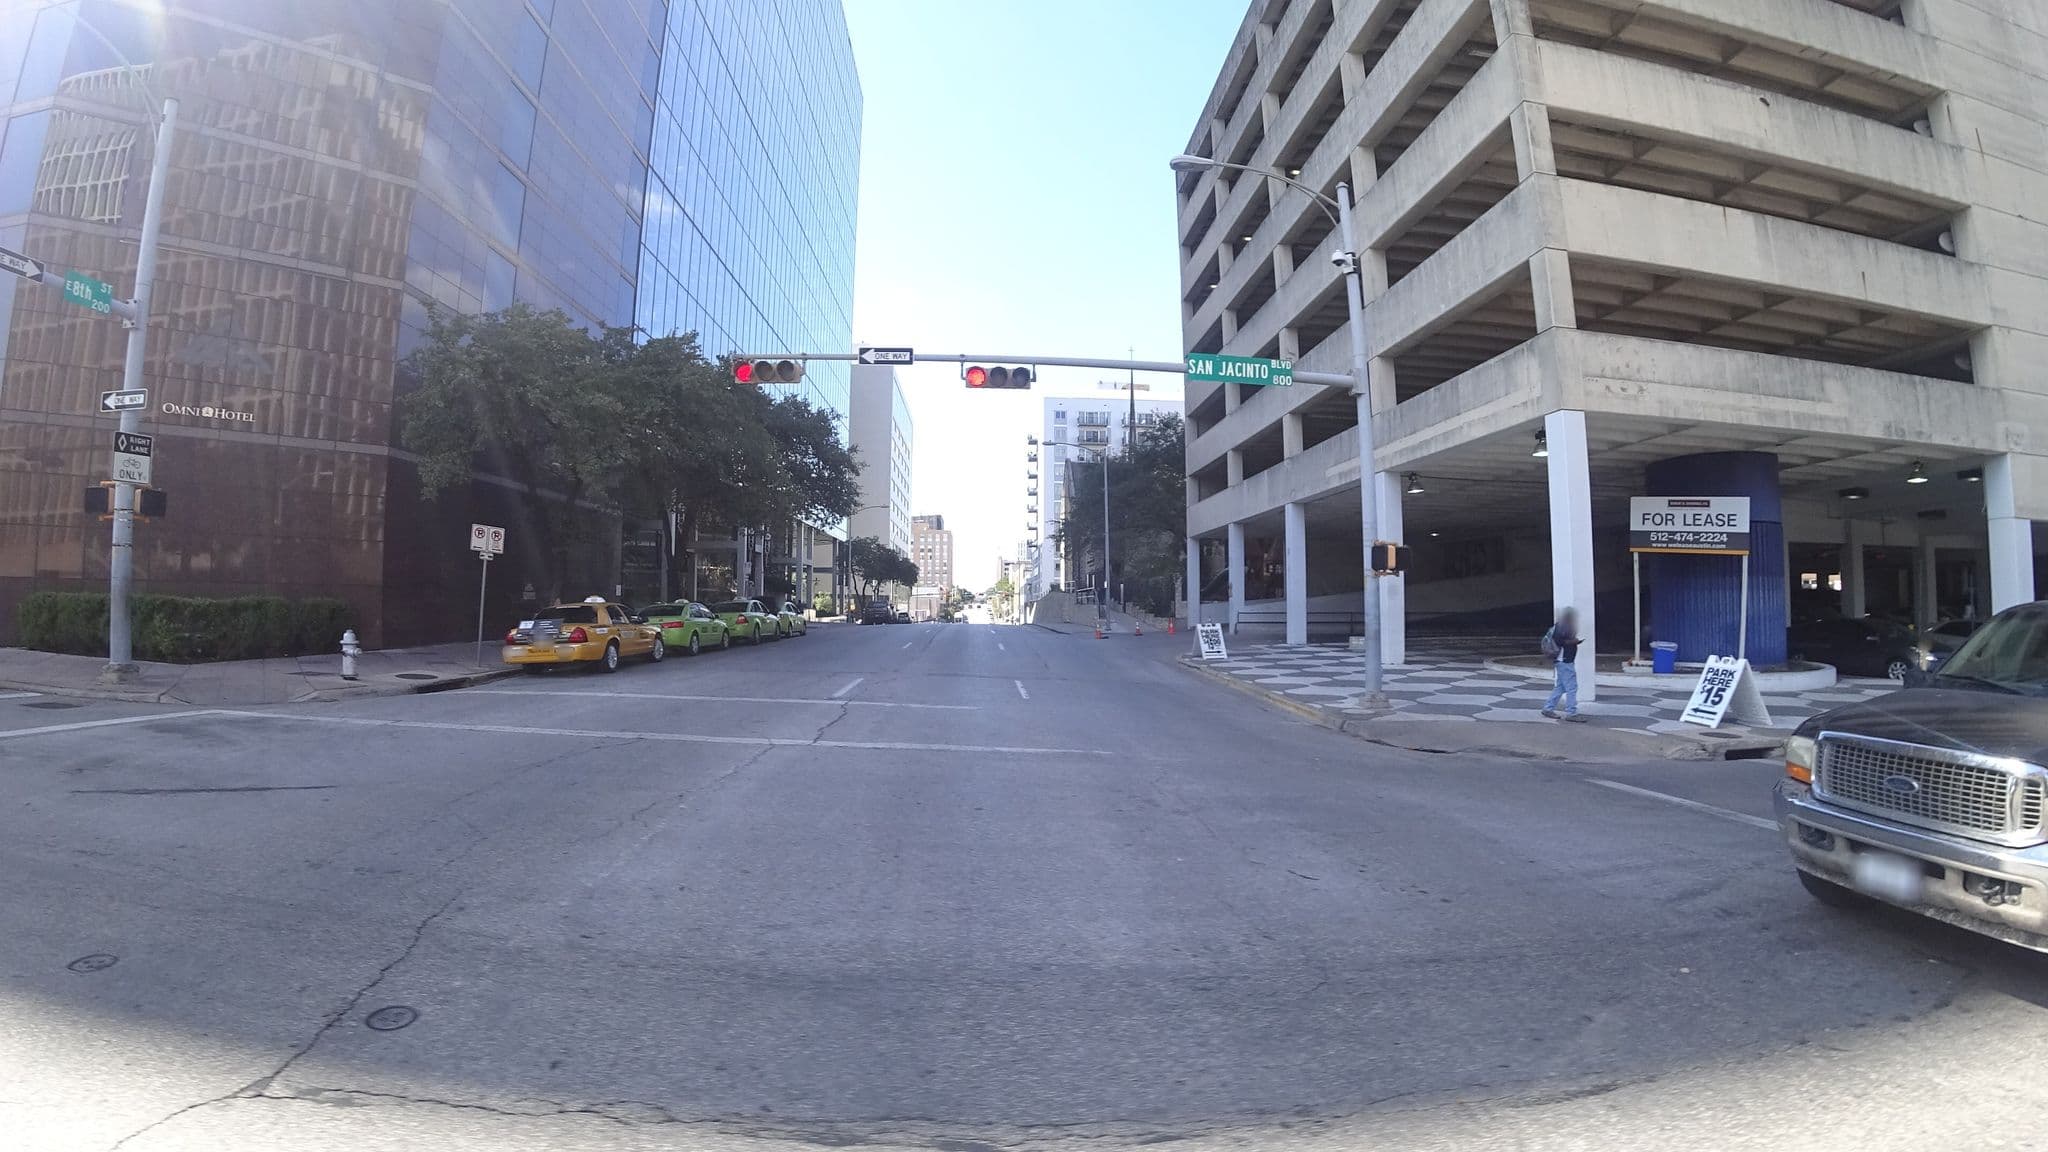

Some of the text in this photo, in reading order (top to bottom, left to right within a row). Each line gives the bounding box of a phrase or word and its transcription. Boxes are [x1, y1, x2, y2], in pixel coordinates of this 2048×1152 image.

[66, 280, 92, 300] E 8th
[100, 283, 113, 295] ST
[91, 299, 110, 313] 200
[874, 352, 908, 360] ONE WAY
[1188, 359, 1268, 379] SAN JACINTO
[1271, 360, 1292, 370] BLVD
[1272, 375, 1292, 386] 800
[162, 402, 256, 423] OMNI HOTEL
[129, 436, 150, 446] RIGHT
[131, 445, 149, 454] LANE
[119, 469, 143, 480] ONLY
[1641, 512, 1738, 527] FOR LEASE
[1650, 532, 1728, 542] 512-474-2224
[1705, 667, 1736, 679] PARK
[1702, 676, 1733, 688] HERE
